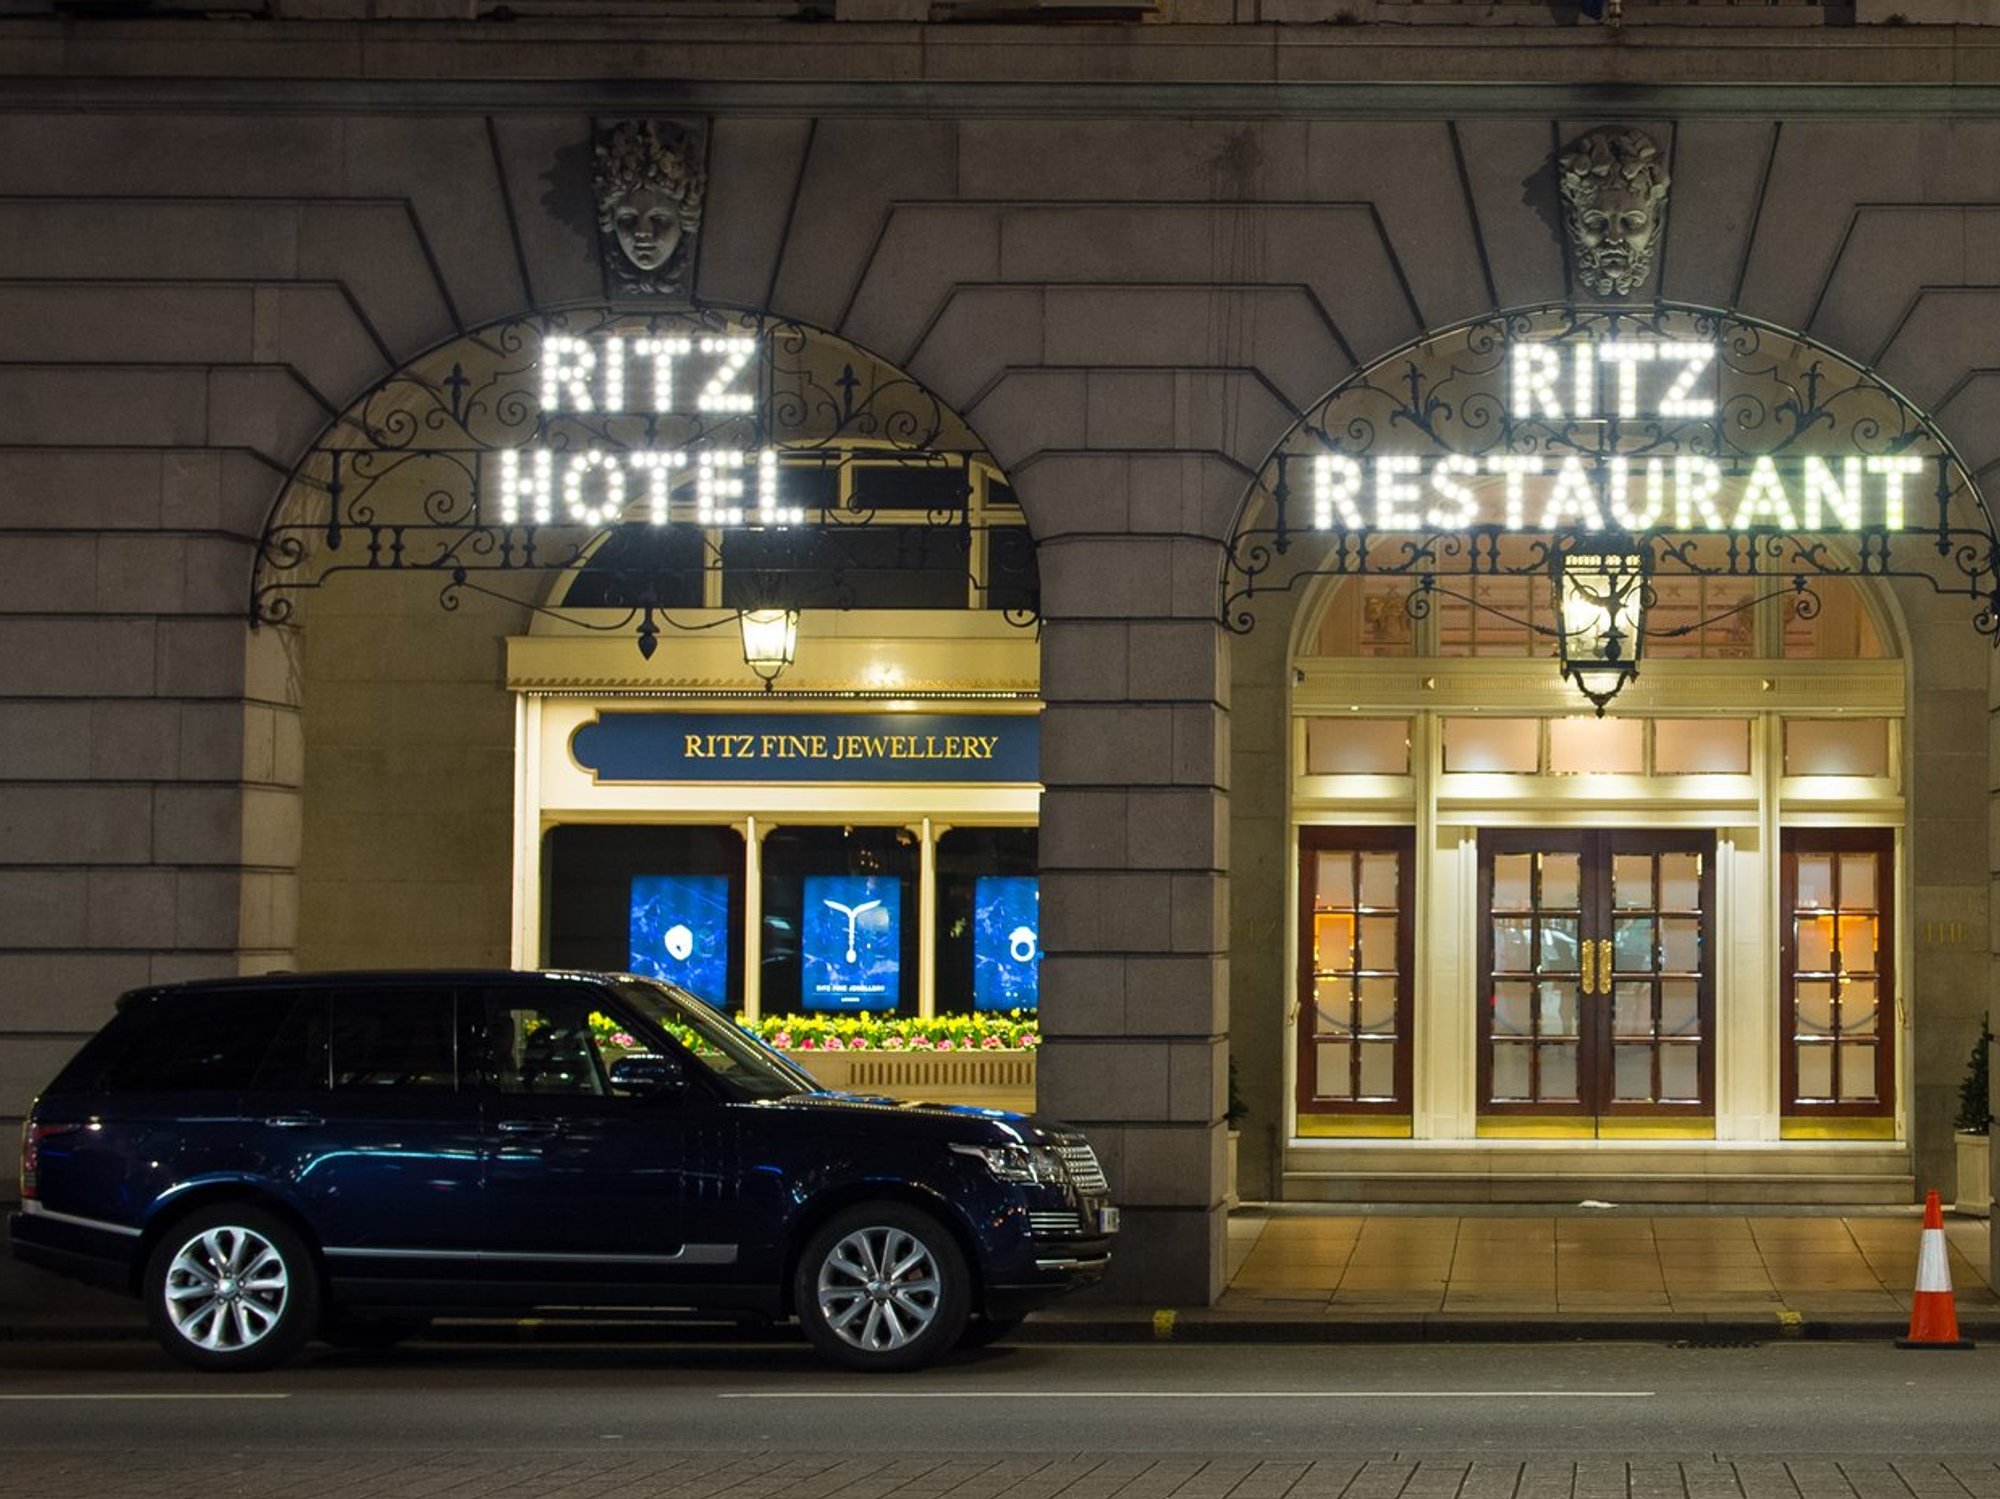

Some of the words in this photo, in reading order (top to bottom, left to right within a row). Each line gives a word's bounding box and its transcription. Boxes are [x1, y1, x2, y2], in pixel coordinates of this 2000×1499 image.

[541, 336, 757, 413] RITZ
[1511, 342, 1717, 418] RITZ
[498, 448, 805, 526] HOTEL
[1313, 454, 1924, 531] RESTAURANT
[684, 734, 755, 758] RITZ
[760, 734, 828, 758] FINE
[833, 735, 998, 760] JEWELLERY
